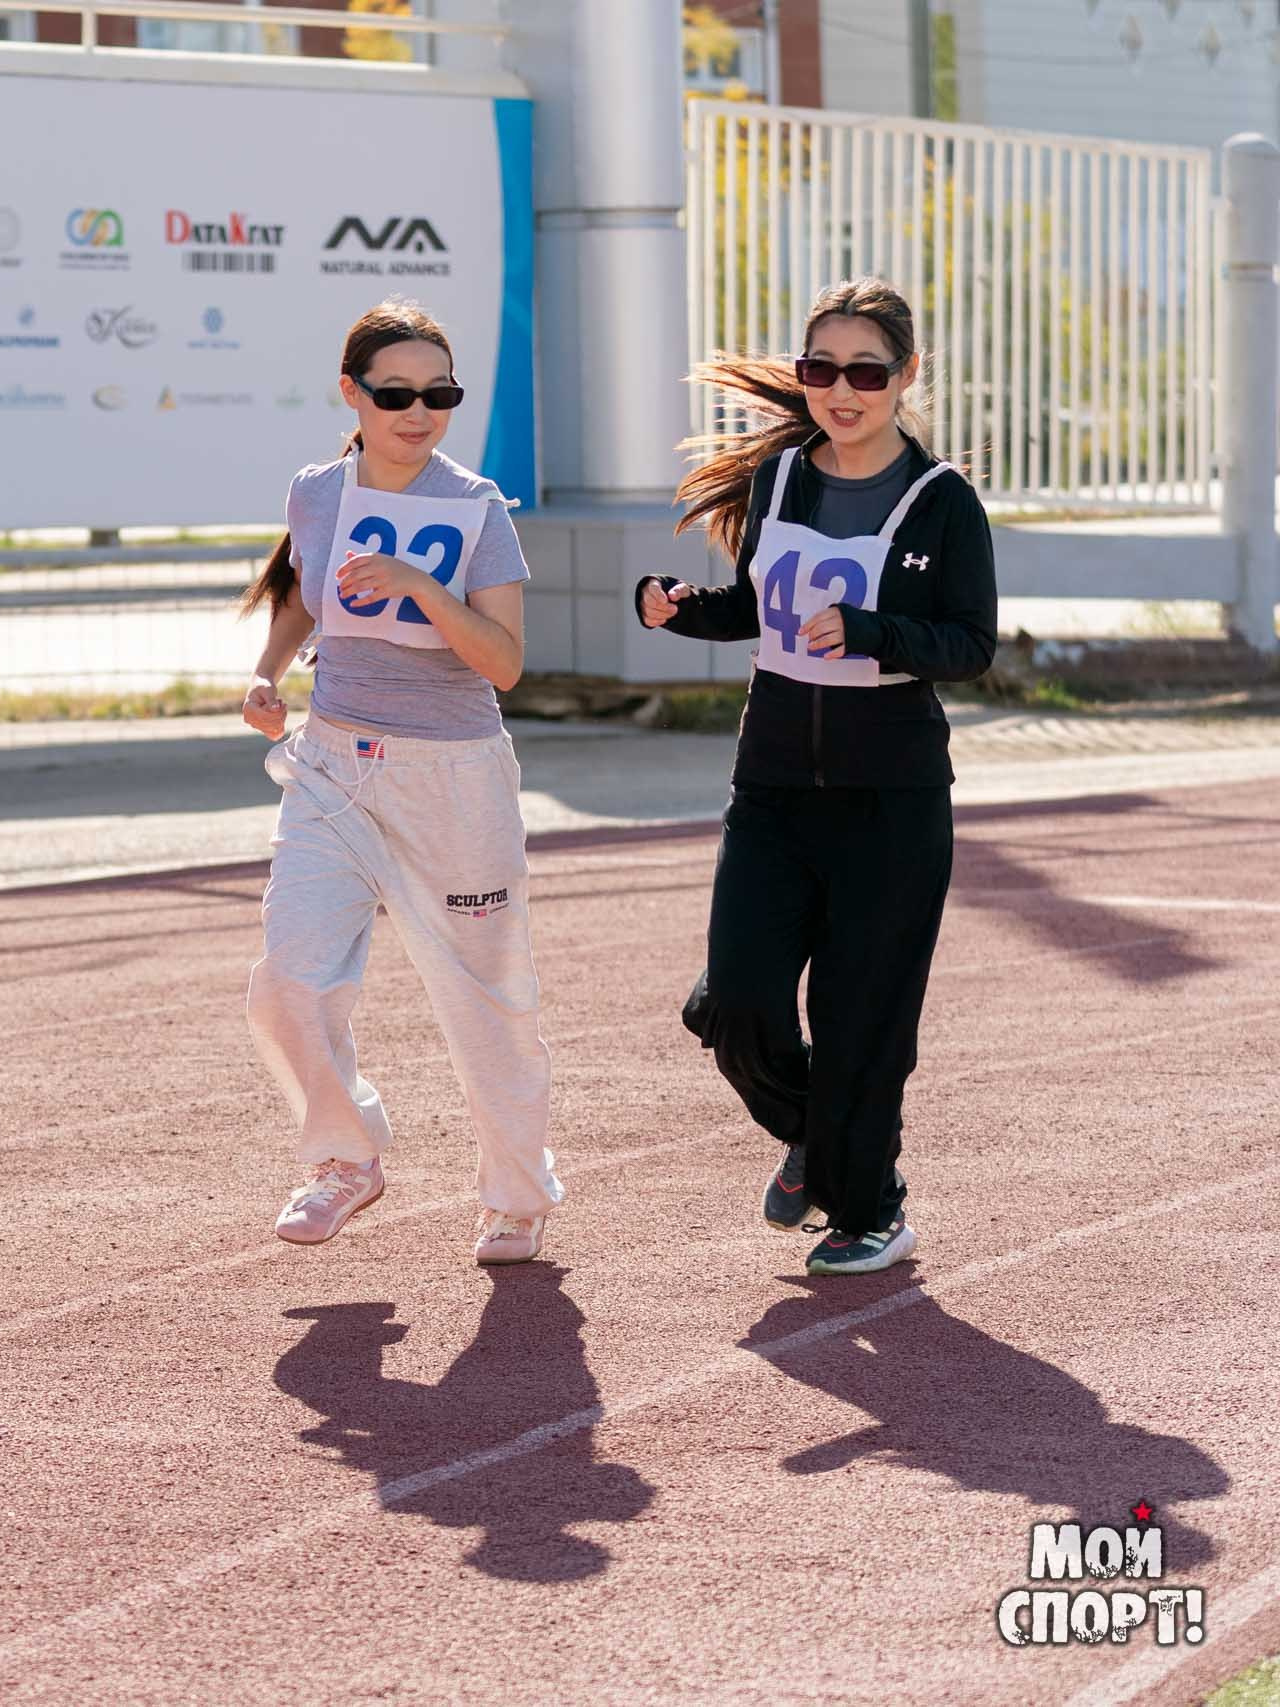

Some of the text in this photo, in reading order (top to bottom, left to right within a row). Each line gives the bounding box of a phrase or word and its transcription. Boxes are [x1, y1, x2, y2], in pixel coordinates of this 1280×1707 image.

[320, 261, 450, 277] NATURAL ADVANCE
[763, 550, 870, 660] 42
[446, 887, 508, 907] SCULPTOR
